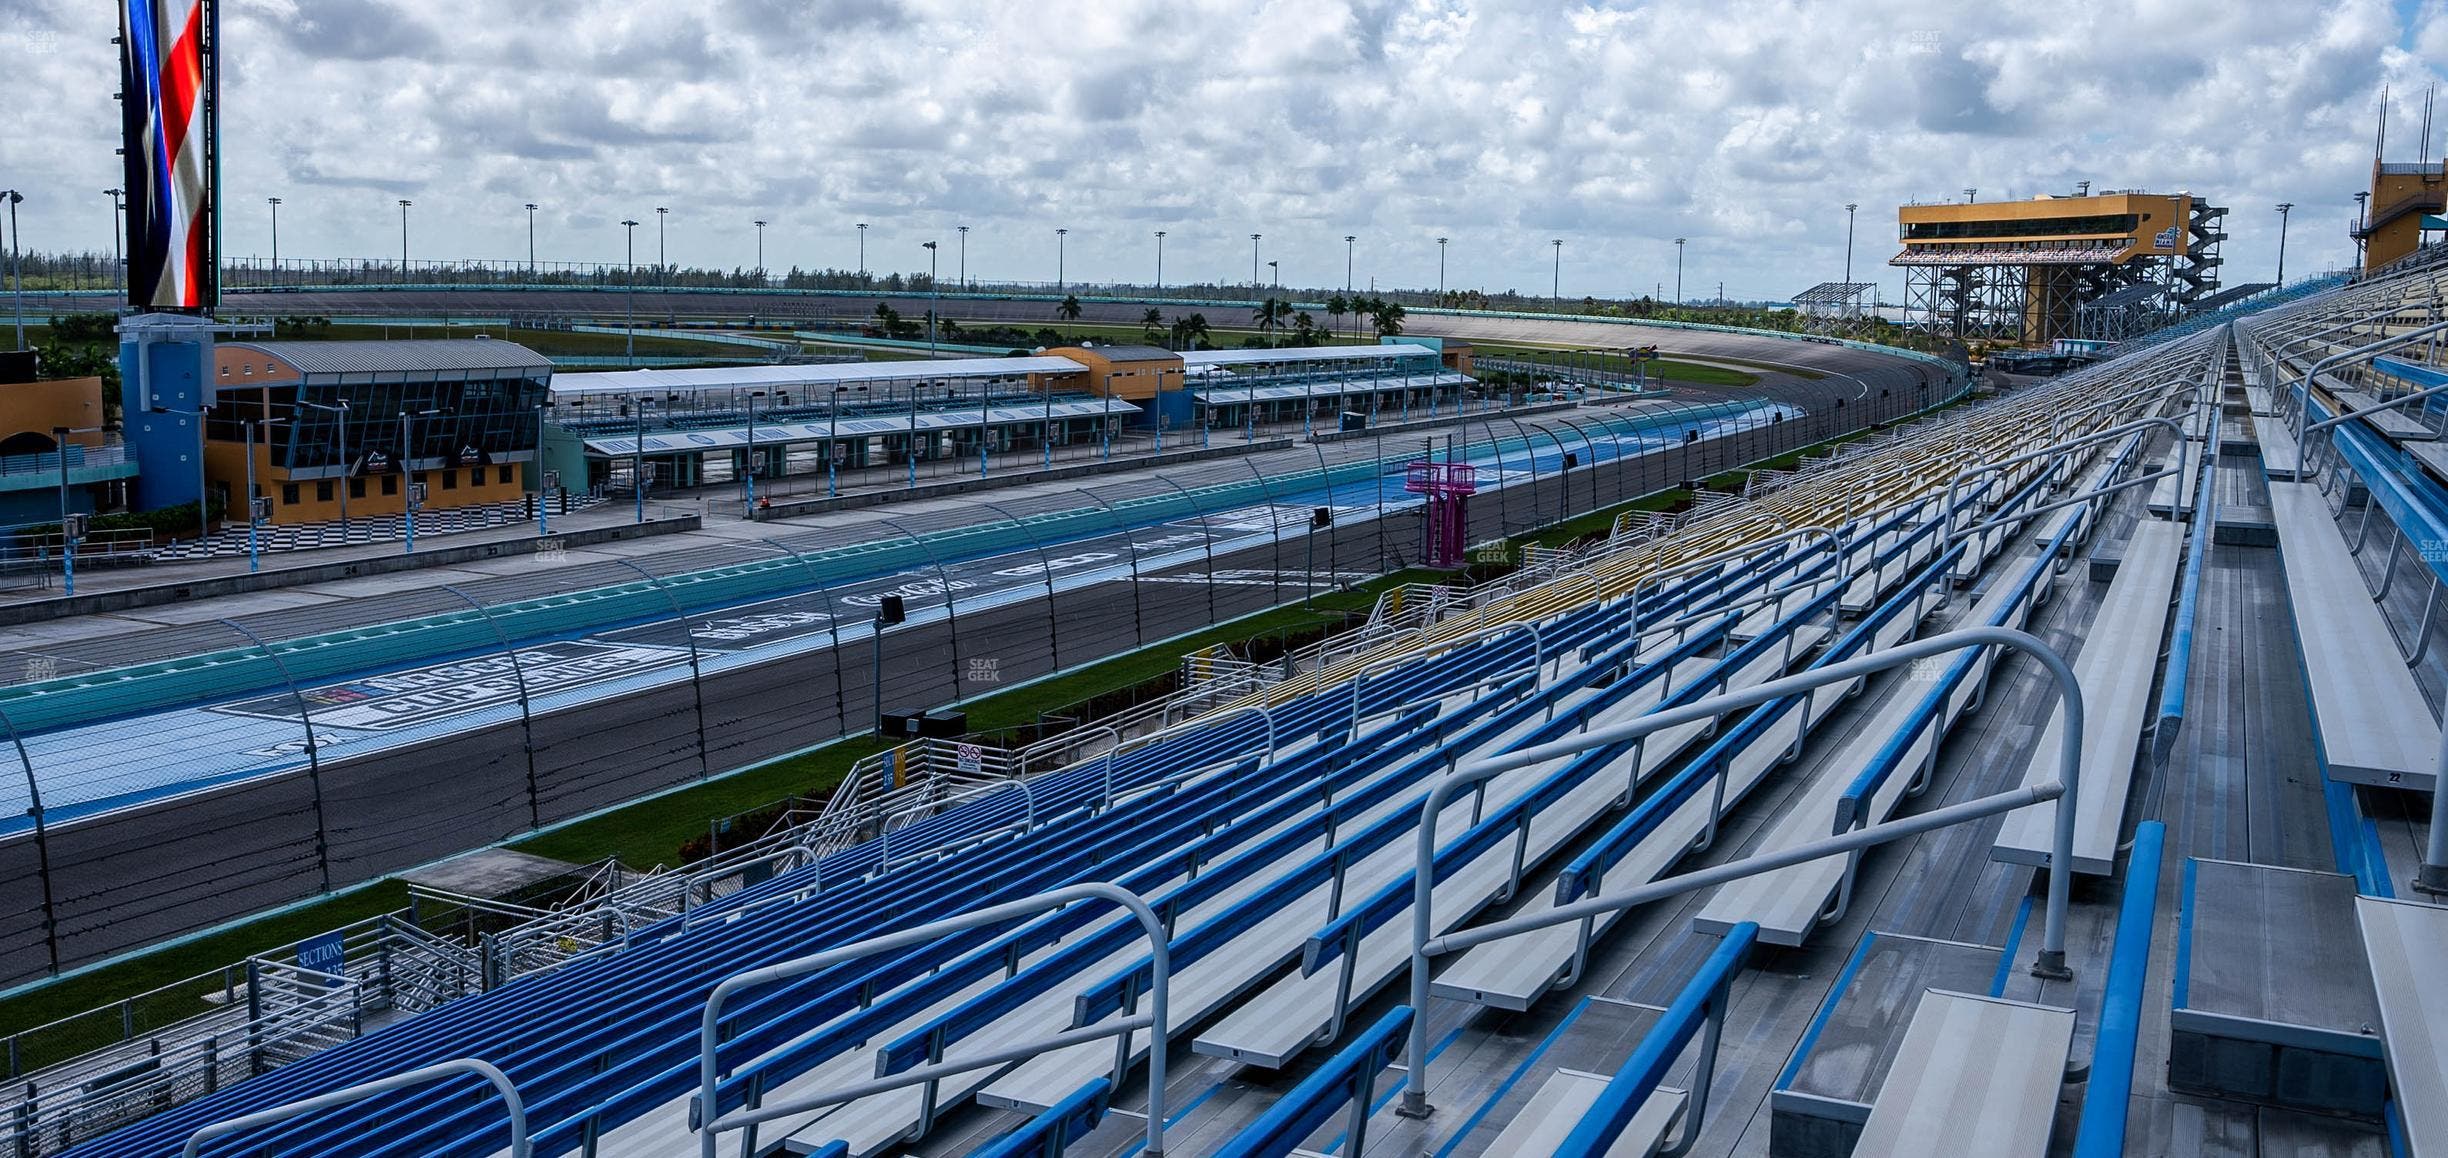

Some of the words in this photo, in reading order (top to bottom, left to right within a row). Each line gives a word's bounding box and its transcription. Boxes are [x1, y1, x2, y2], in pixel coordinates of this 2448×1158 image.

[364, 650, 568, 692] NASCAR
[366, 686, 474, 714] CUP
[473, 655, 642, 692] SERIES
[2389, 772, 2401, 782] 22
[299, 941, 342, 966] SECTIONS
